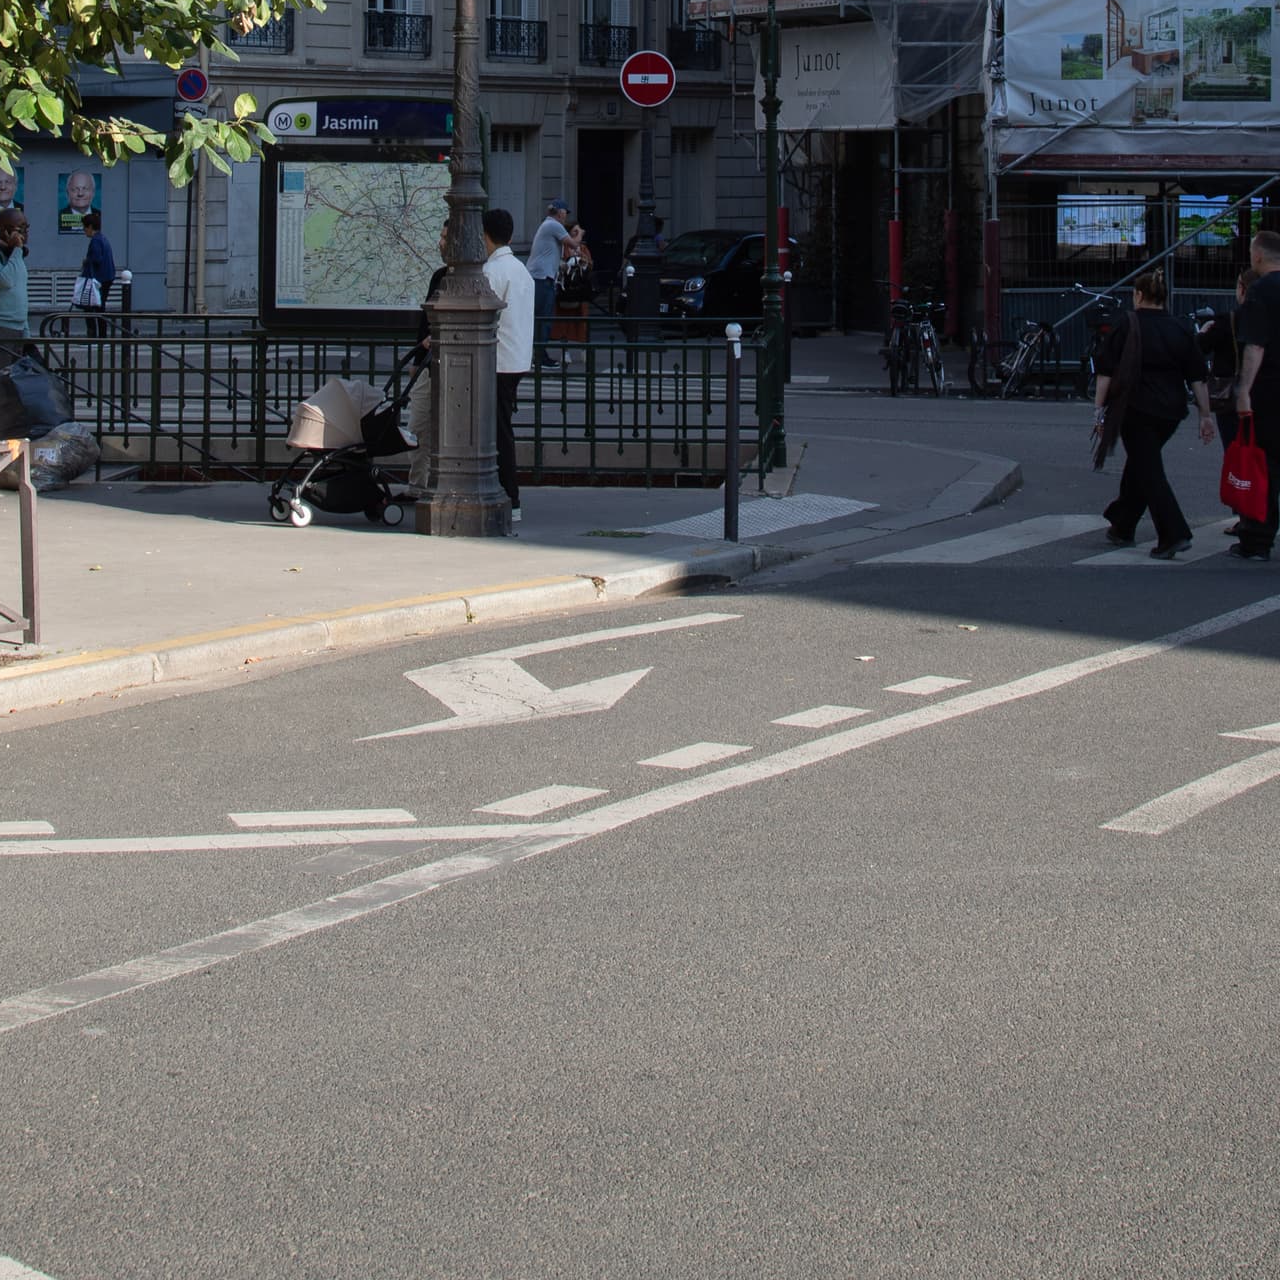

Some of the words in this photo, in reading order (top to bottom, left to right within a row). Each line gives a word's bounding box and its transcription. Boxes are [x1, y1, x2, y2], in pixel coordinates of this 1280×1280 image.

[793, 44, 841, 80] Junot
[1026, 92, 1099, 116] Junot
[299, 116, 307, 128] 9
[322, 114, 379, 131] Jasmin
